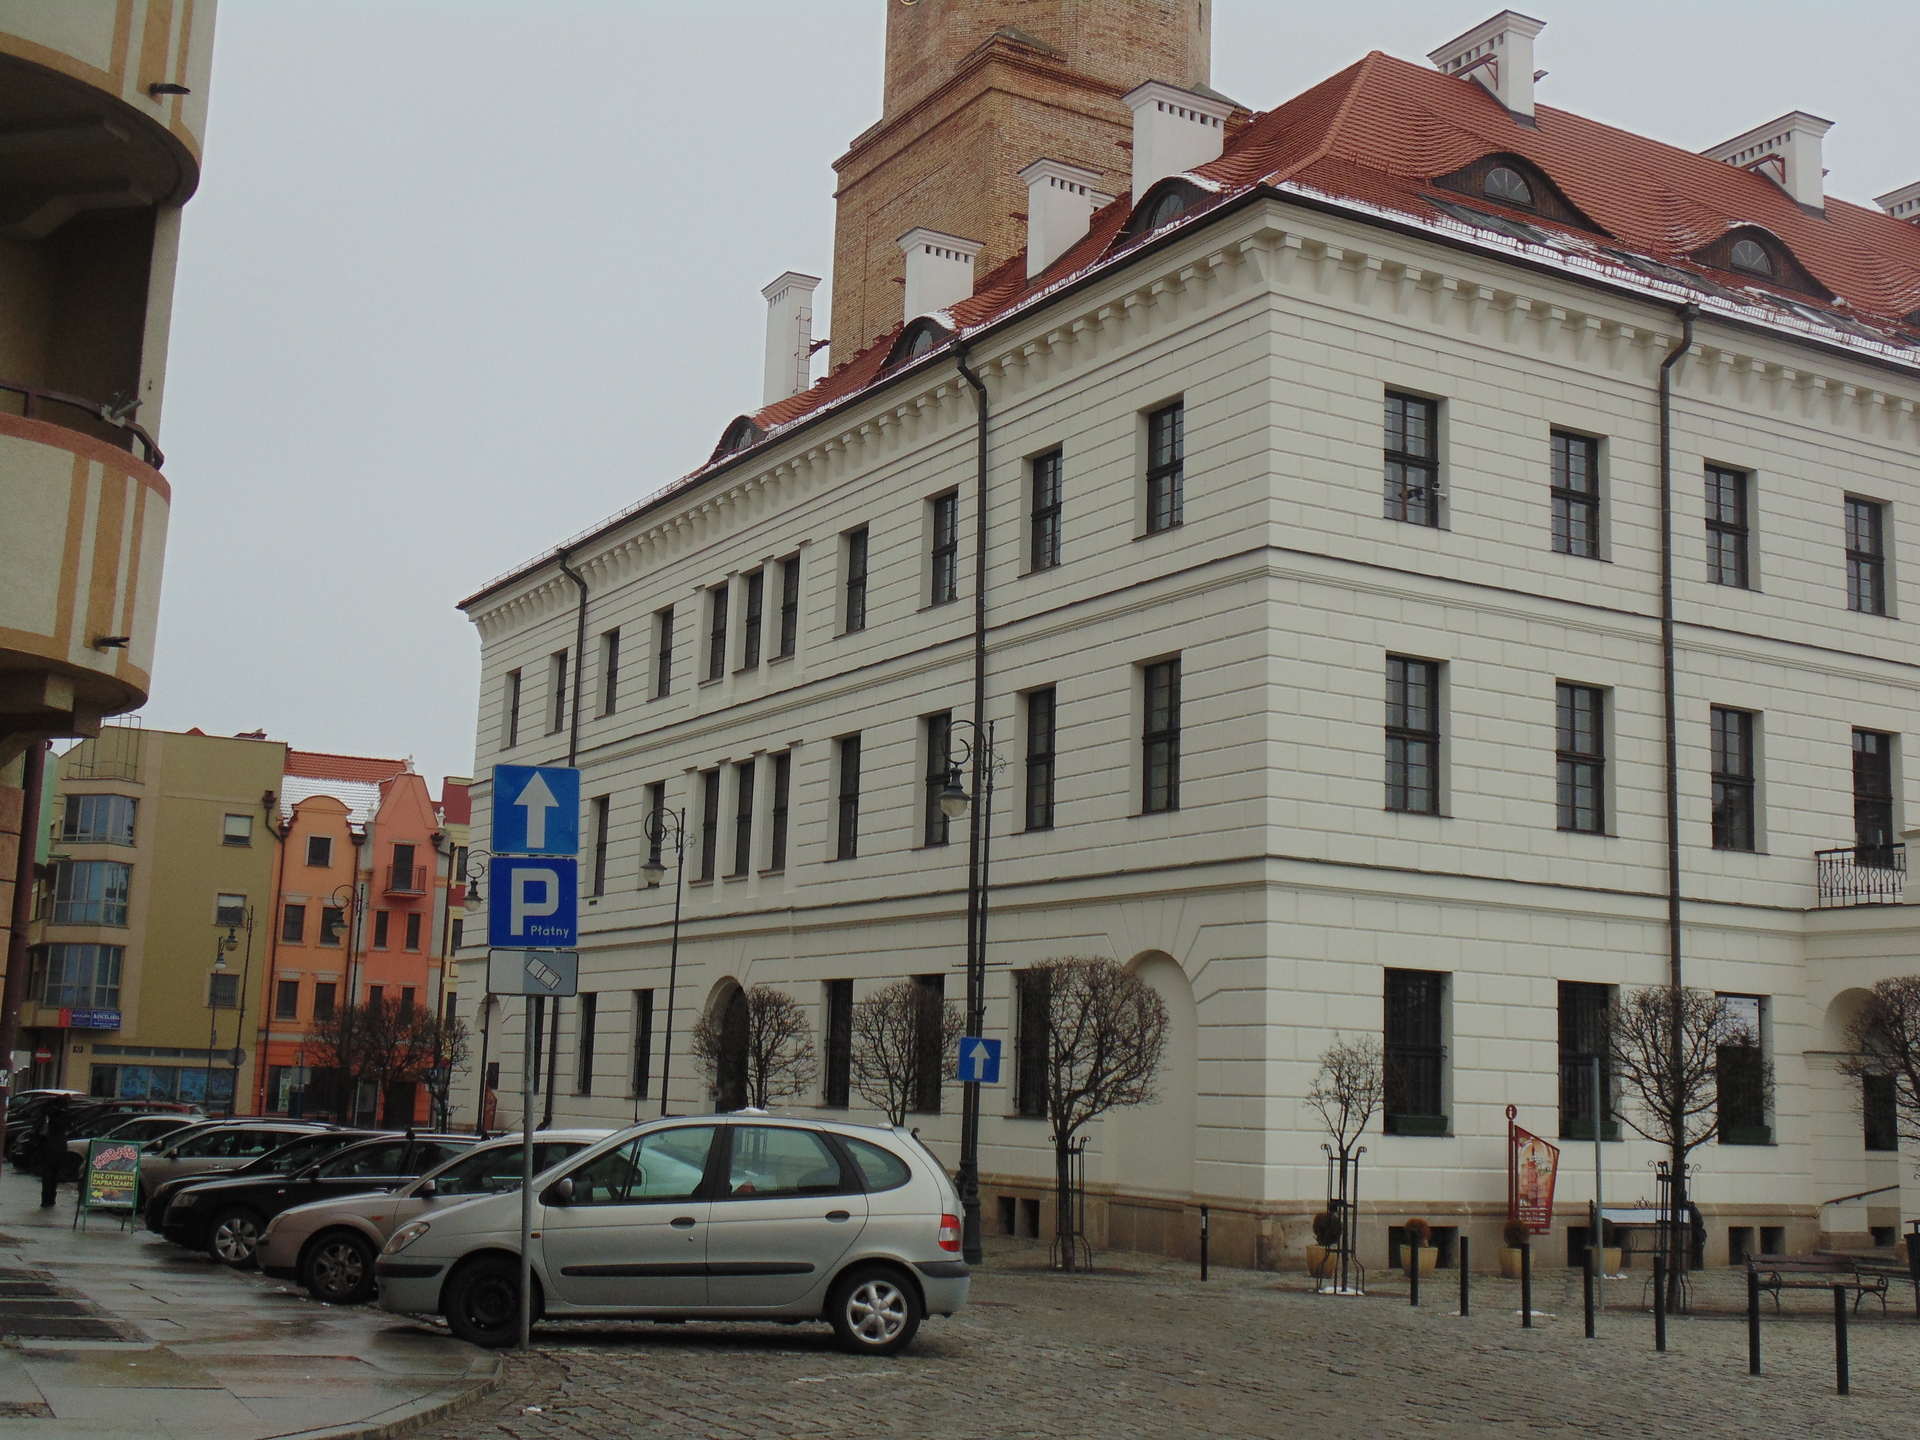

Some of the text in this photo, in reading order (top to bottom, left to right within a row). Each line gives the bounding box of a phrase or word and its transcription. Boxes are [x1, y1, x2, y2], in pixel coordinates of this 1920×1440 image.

[510, 868, 559, 936] P
[530, 925, 570, 939] Płatny
[93, 1145, 138, 1169] KEBAB
[92, 1179, 134, 1187] ZAPRASZAMY
